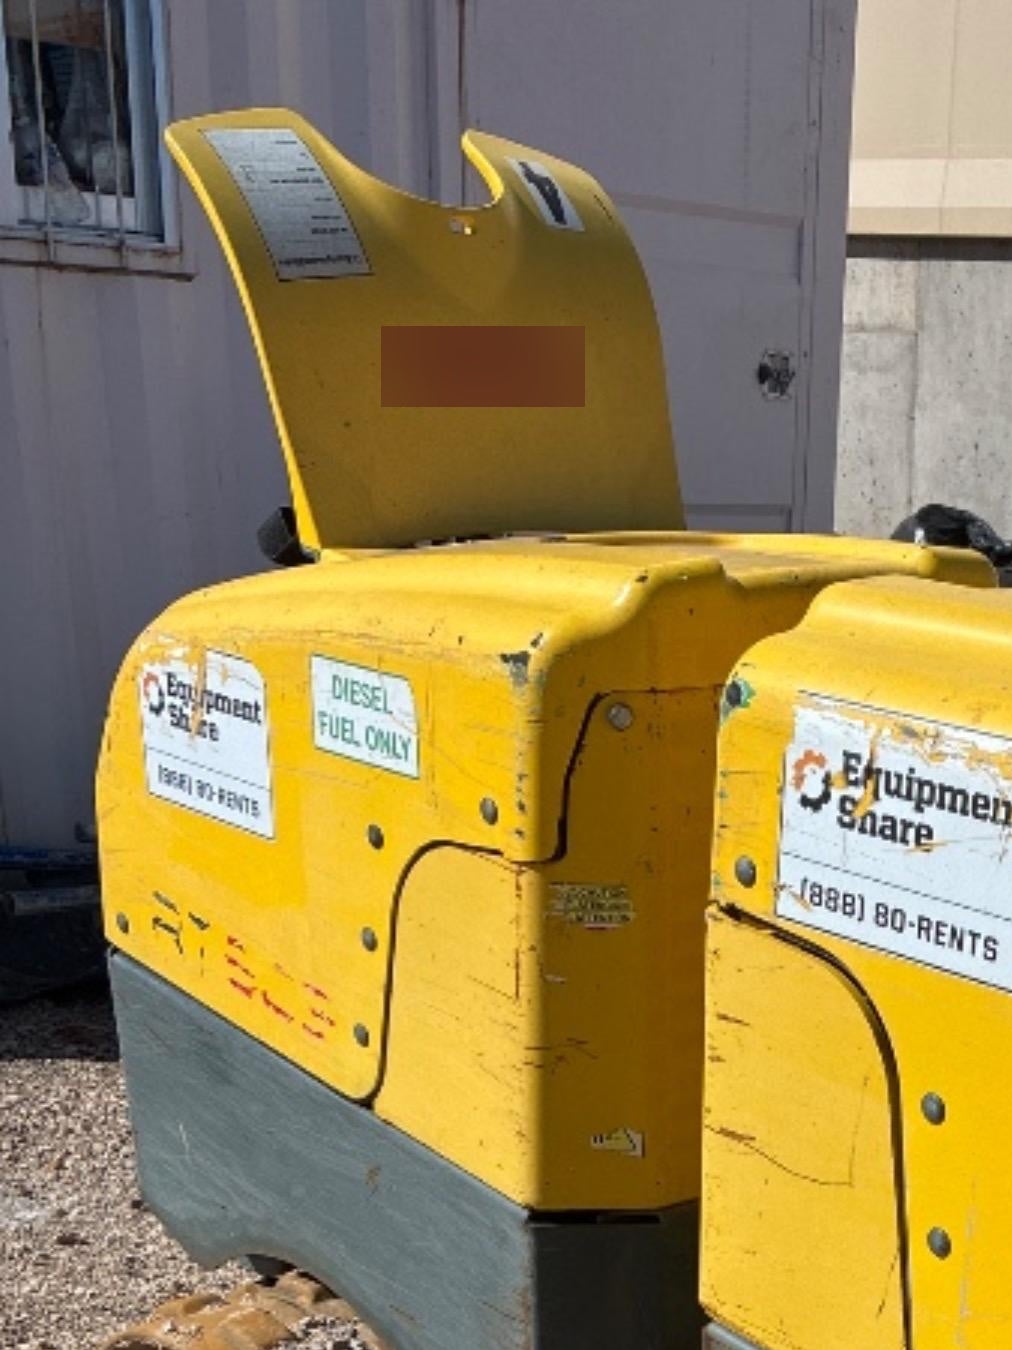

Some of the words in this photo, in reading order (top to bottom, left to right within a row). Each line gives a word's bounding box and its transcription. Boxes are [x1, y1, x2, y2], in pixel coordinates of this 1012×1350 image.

[332, 674, 394, 715] DIESEL
[317, 711, 361, 748] FUEL
[365, 725, 412, 762] ONLY
[800, 877, 865, 922] (888)
[875, 902, 999, 962] 80-RENTS
